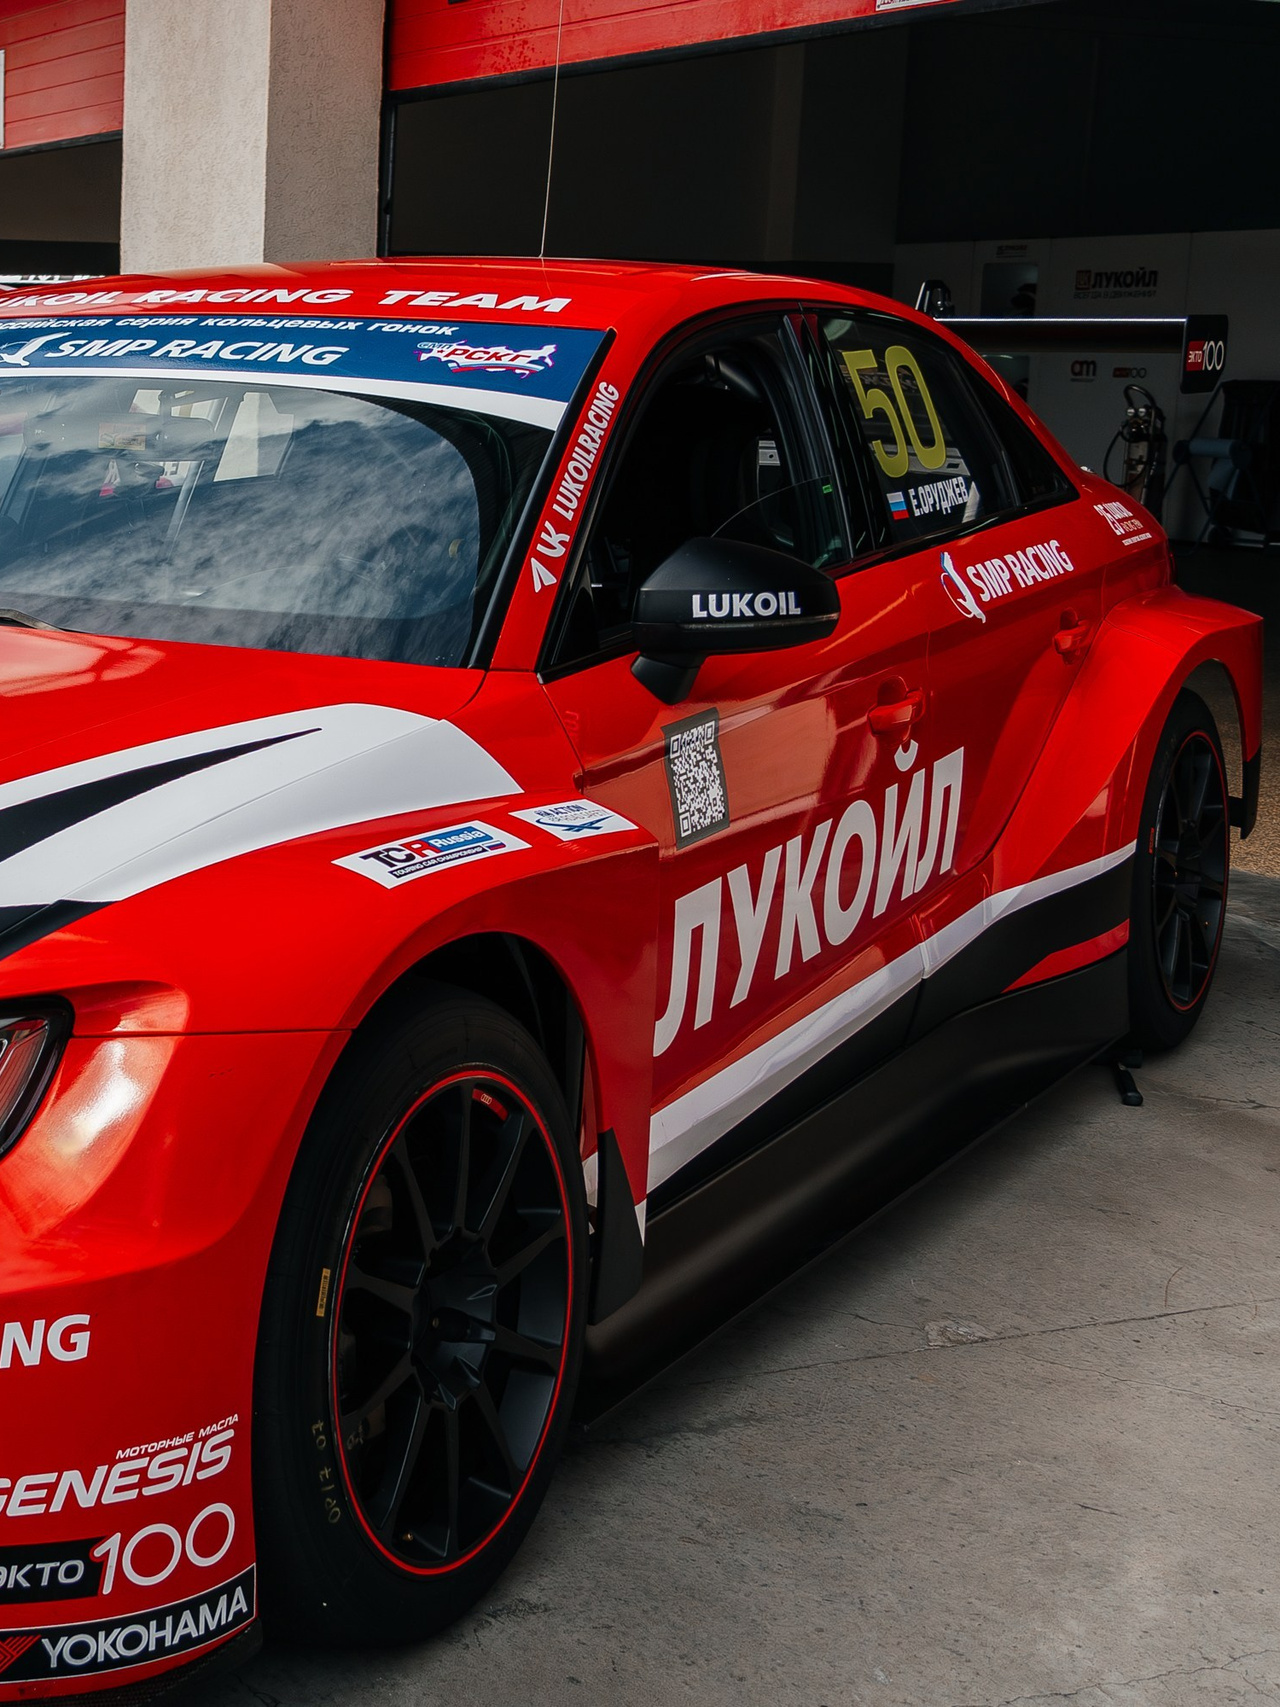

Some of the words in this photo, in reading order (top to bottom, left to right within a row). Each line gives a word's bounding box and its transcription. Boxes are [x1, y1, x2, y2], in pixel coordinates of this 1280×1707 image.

[1091, 266, 1158, 289] ЛУКОЙЛ
[130, 289, 354, 304] RACING
[377, 290, 572, 313] TEAM
[115, 318, 199, 329] серия
[199, 317, 363, 333] кольцевых
[374, 322, 461, 336] гонок
[44, 339, 158, 358] SMP
[149, 339, 352, 366] RACING
[444, 348, 532, 362] РСКГ
[1202, 340, 1225, 371] 100
[842, 345, 946, 478] 50
[552, 381, 620, 521] LUKOILRACING
[908, 476, 969, 517] Е.ОРУДЖЕВ
[966, 558, 1013, 602] SMP
[1003, 539, 1074, 588] RACING
[692, 591, 801, 619] LUKOIL
[359, 839, 442, 868] TCR
[428, 830, 486, 848] Russia
[392, 863, 424, 878] TOURING
[422, 857, 438, 867] CAR
[652, 740, 964, 1058] ЛУКОЙЛ
[116, 1431, 195, 1460] МОТОРНЫЕ
[198, 1413, 240, 1438] МАСЛА
[93, 1502, 236, 1595] 100
[41, 1585, 248, 1669] YOKOHAMA
